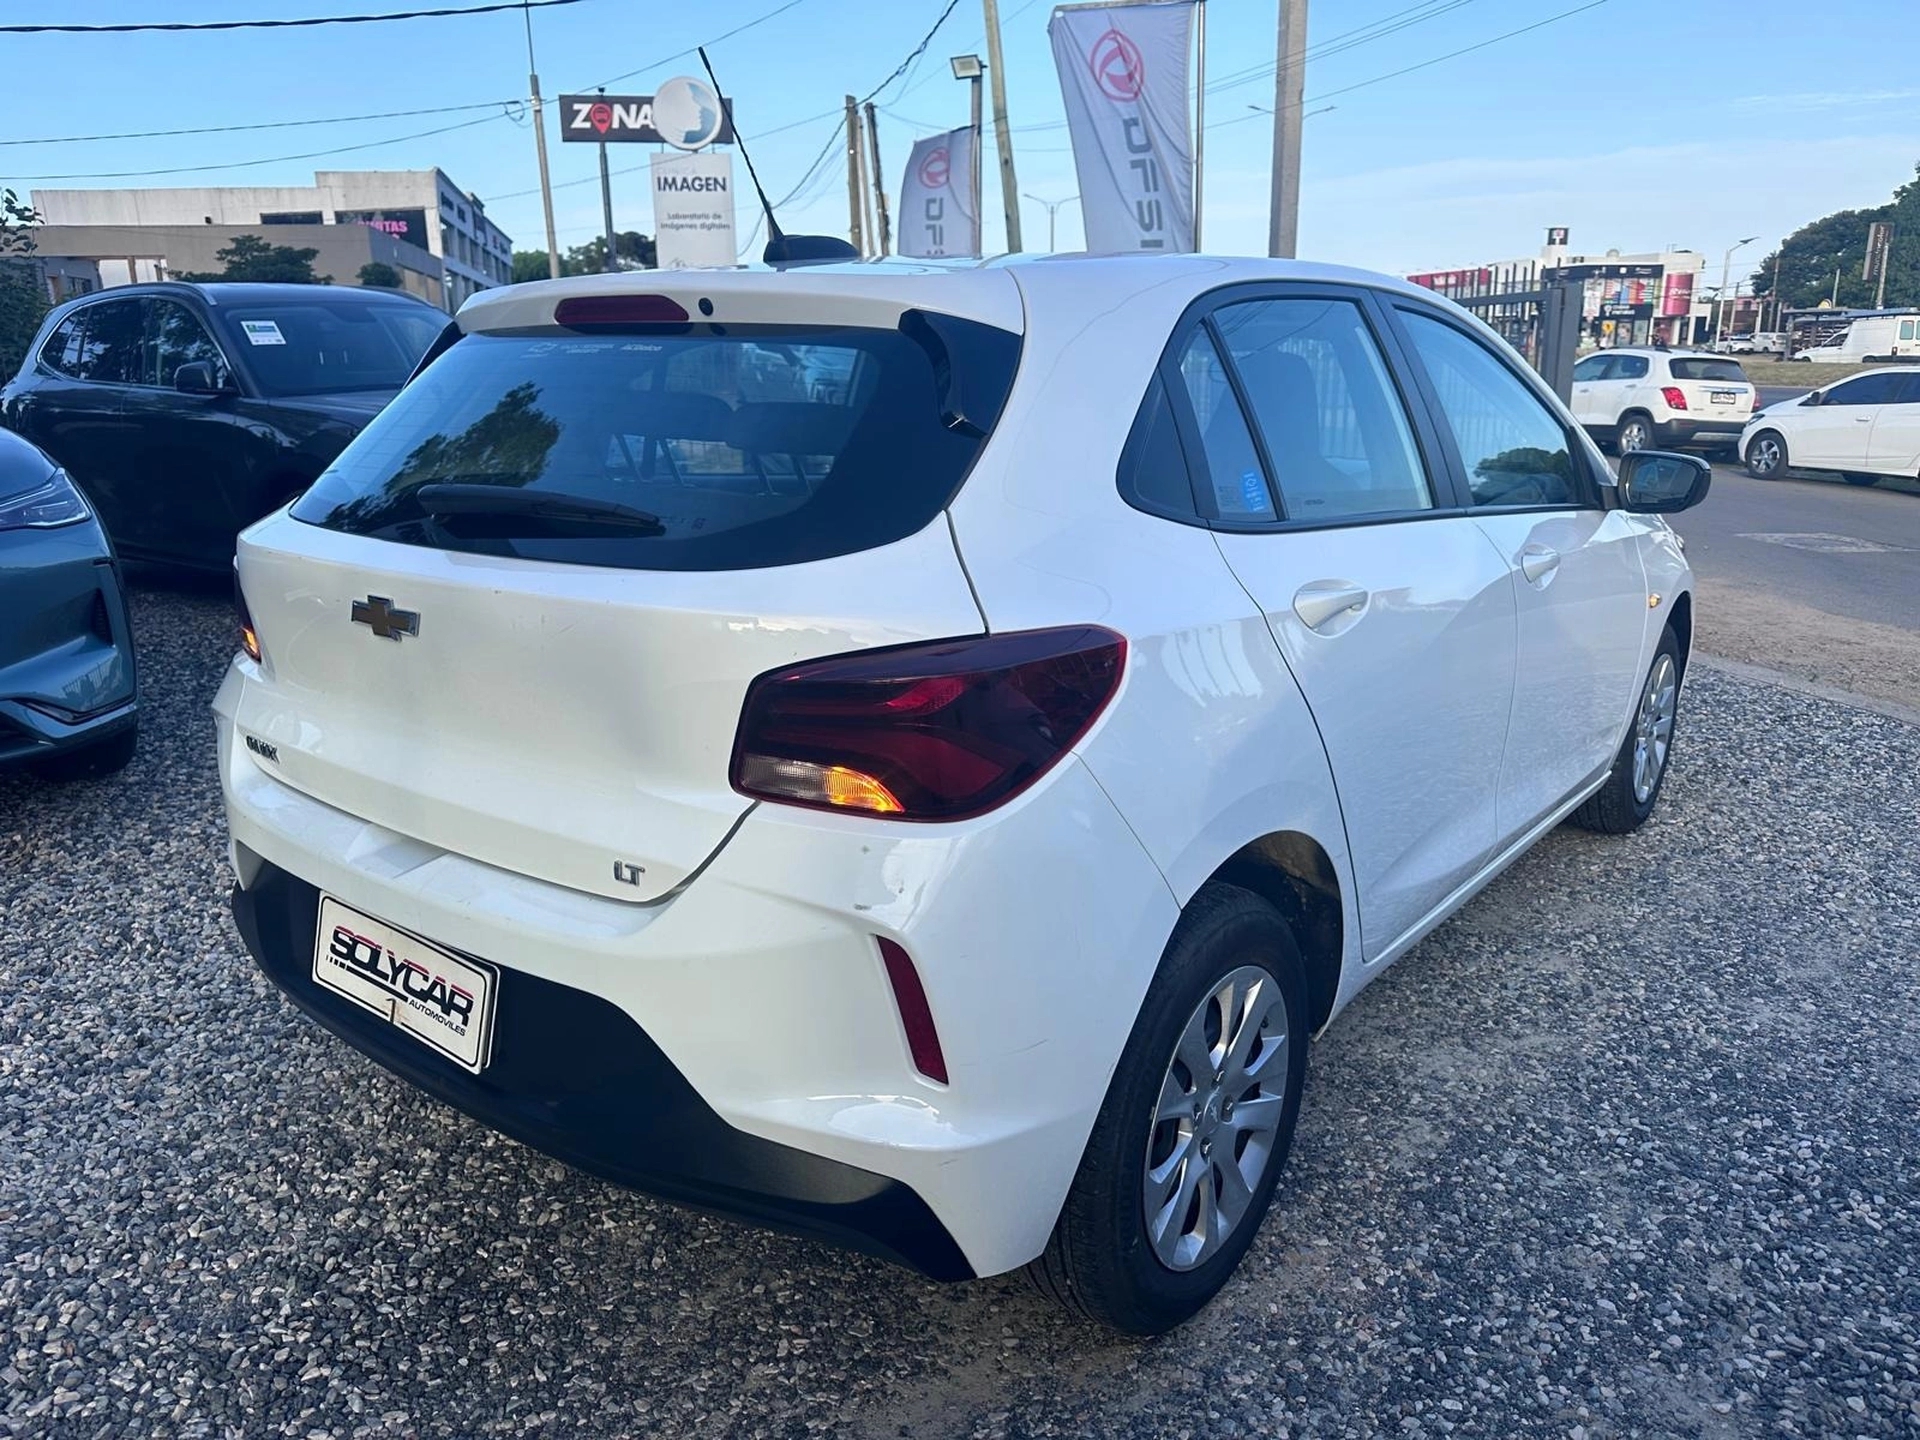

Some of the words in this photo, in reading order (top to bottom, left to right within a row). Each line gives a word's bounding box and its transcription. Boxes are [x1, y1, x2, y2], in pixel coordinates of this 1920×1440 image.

[657, 176, 727, 192] IMAGEN
[613, 860, 646, 887] LT
[330, 925, 475, 1028] SOLYCAR
[408, 999, 467, 1038] AUTOMOVILES
